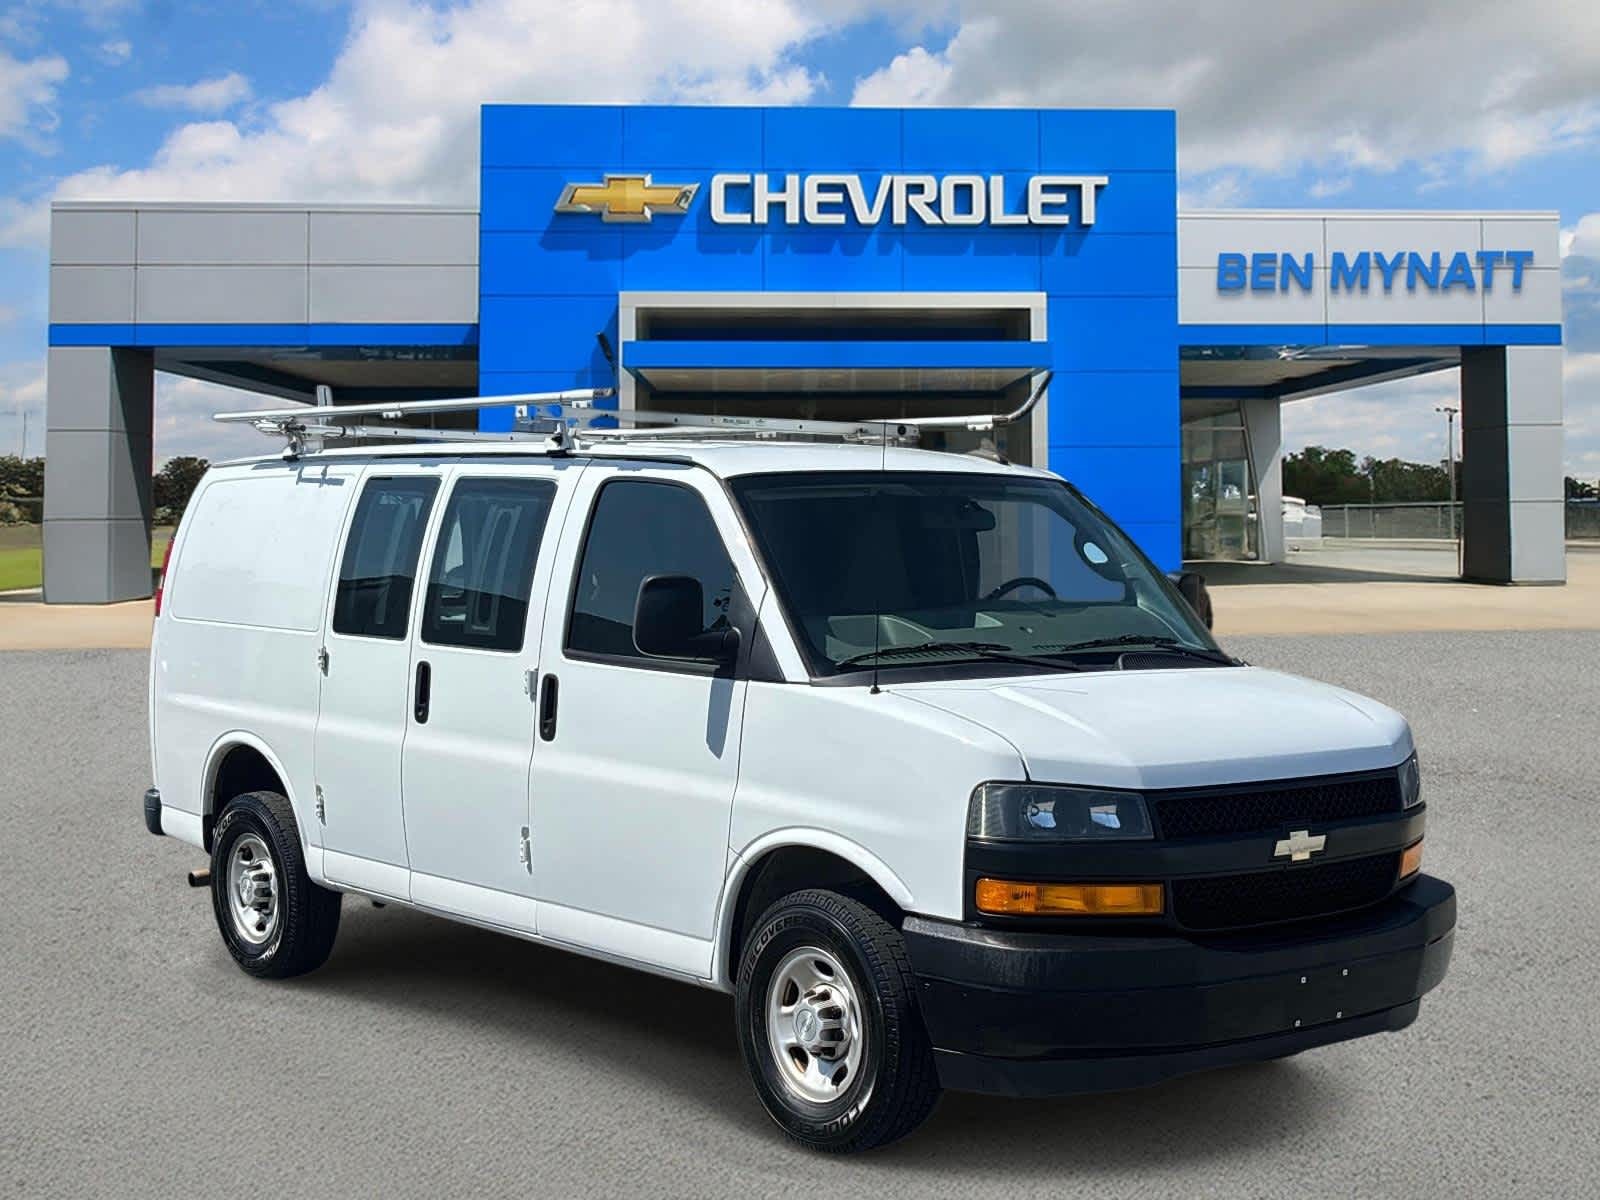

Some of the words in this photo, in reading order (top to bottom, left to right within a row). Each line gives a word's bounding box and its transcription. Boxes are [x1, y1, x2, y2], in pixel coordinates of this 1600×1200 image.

[710, 173, 1109, 225] CHEVROLET
[1216, 252, 1314, 291] BEN
[1329, 250, 1535, 291] MYNATT
